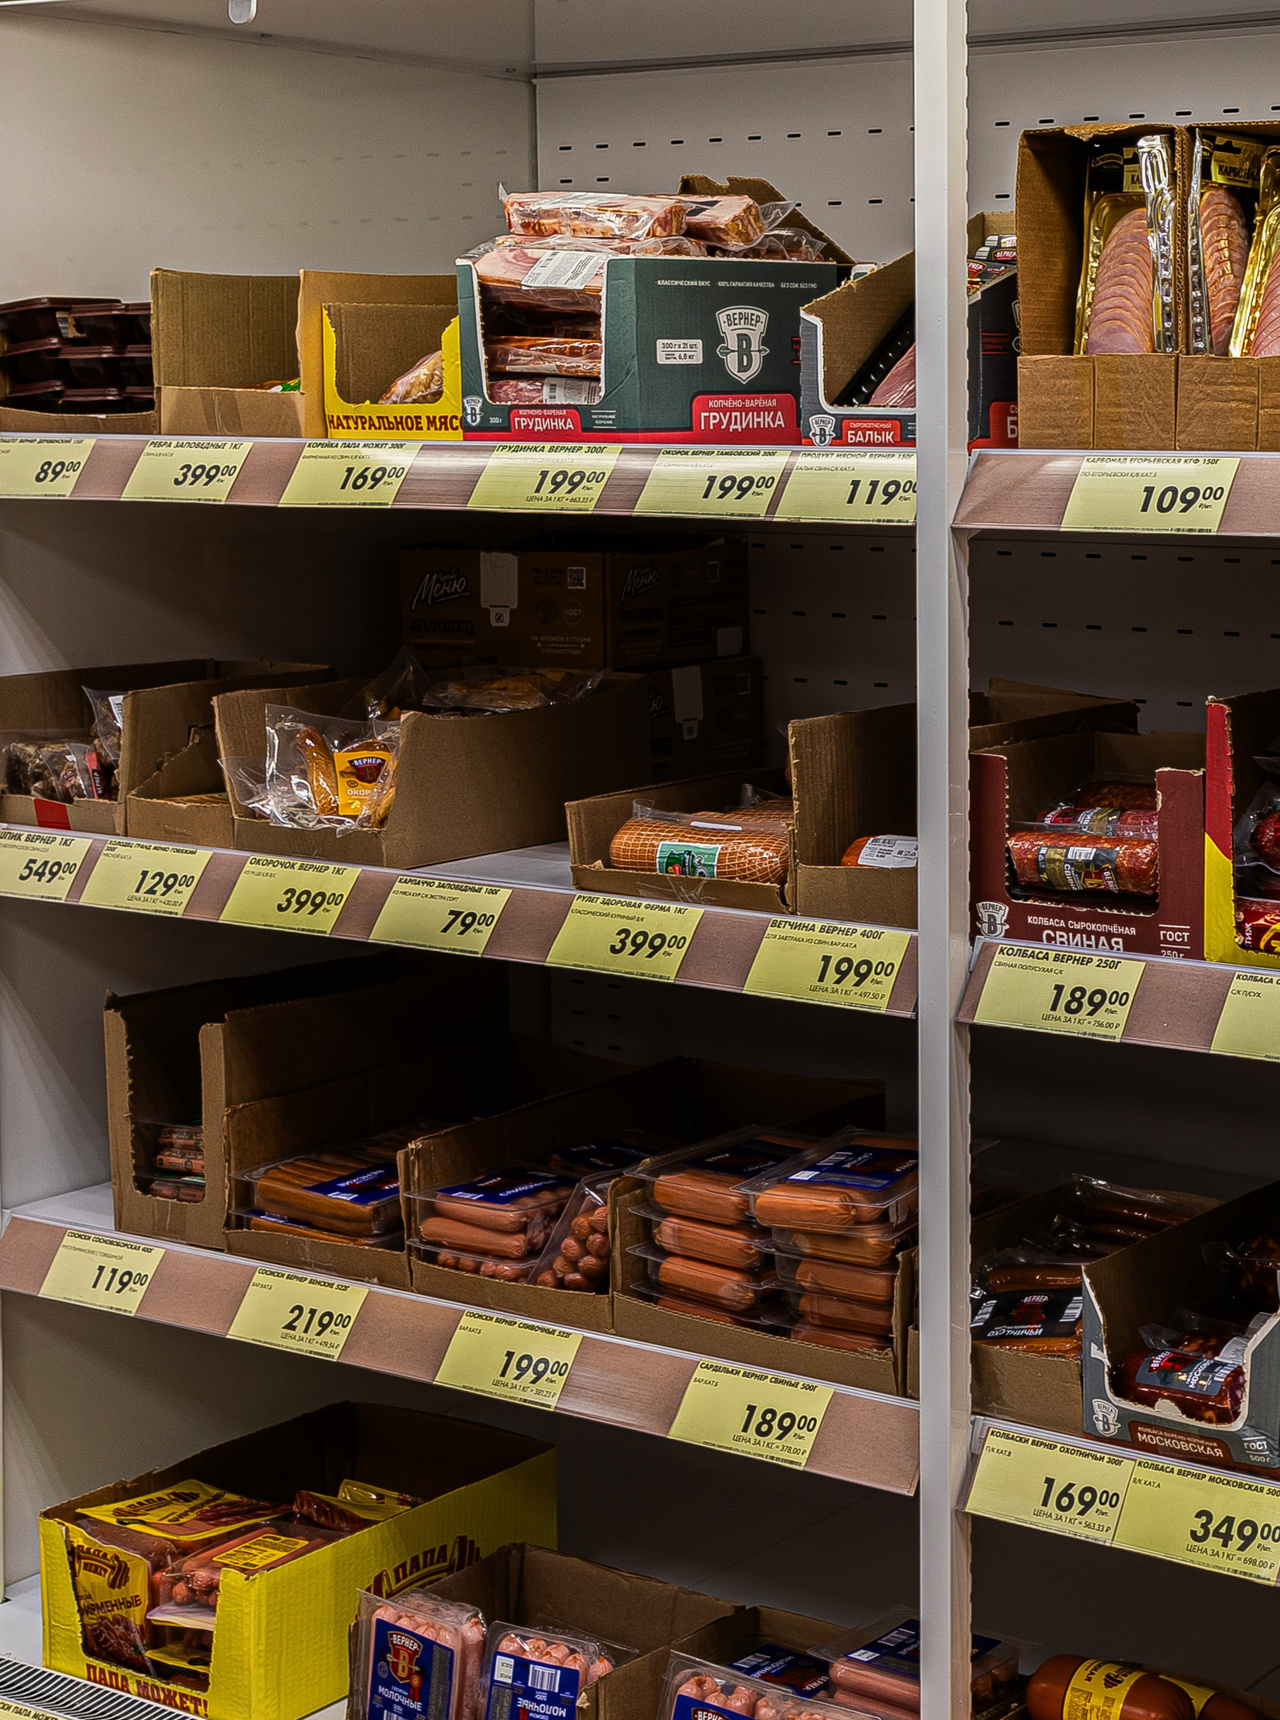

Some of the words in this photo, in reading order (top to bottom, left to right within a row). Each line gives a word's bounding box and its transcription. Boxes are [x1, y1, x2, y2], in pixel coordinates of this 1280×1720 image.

[726, 312, 761, 327] ВЕРНЕР
[328, 414, 424, 431] НАТУРАЛЬНОЕ
[514, 418, 574, 431] ГРУДИНКА
[700, 411, 785, 432] ГРУДИНКА
[149, 441, 172, 449] РЕБРА
[172, 442, 228, 450] ЗАПОВЕДНЫЕ
[306, 442, 339, 450] КОРЕЙКА
[848, 430, 894, 445] БАЛЫК
[496, 444, 546, 454] ГРУДИНКА
[548, 446, 582, 454] ВЕРНЕР
[585, 446, 607, 454] 300Г
[716, 450, 761, 458] ТАМБОВСКИЙ
[835, 452, 866, 460] МЯСНОЙ
[354, 758, 382, 766] ВЕРНЕР
[24, 834, 56, 844] ВЕРНЕР
[250, 856, 297, 870] ОКОРОЧОК
[298, 861, 330, 875] ВЕРНЕР
[398, 877, 436, 888] КАРПАЧЧО
[436, 881, 484, 894] ЗАПОВЕДНЫЕ
[576, 894, 598, 904] РУЛЕТ
[600, 896, 642, 909] ЗДОРОВАЯ
[644, 902, 672, 913] ФЕРМА
[770, 919, 818, 934] ВЕТЧИНА
[819, 924, 858, 938] ВЕРНЕР
[860, 929, 885, 941] 400Г
[1028, 916, 1066, 928] КОЛБАСА
[1068, 920, 1136, 936] СЫРОКОПЧЁНАЯ
[1042, 930, 1124, 952] СВИНАЯ
[1160, 930, 1190, 942] ГОСТ
[998, 946, 1050, 962] КОЛБАСА
[1052, 952, 1094, 967] ВЕРНЕР
[1096, 958, 1122, 970] 250Г
[1236, 974, 1274, 985] КОЛБАСА
[466, 1311, 494, 1322] СОСИСКИ
[518, 1322, 556, 1336] СЛИВОЧНЫЕ
[987, 1328, 1044, 1337] ОХОТНИЧЬИ
[700, 1362, 741, 1377] САРДЕЛЬКИ
[742, 1370, 769, 1382] ВЕРНЕР
[770, 1376, 800, 1389] СВИНЫЕ
[990, 1429, 1028, 1446] КОЛБАСКИ
[1030, 1437, 1058, 1454] ВЕРНЕР
[1059, 1444, 1104, 1463] ОХОТНИЧЬИ
[1106, 1456, 1124, 1467] 300Г
[1138, 1432, 1224, 1458] МОСКОВСКАЯ
[1244, 1440, 1268, 1451] ГОСТ
[1137, 1460, 1176, 1476] КОЛБАСА
[1177, 1468, 1207, 1483] ВЕРНЕР
[1208, 1474, 1266, 1495] МОСКОВСКАЯ
[394, 1544, 448, 1584] ПАПА
[392, 1635, 418, 1650] ВЕРНЕР
[86, 1663, 130, 1692] ПАПА
[136, 1679, 208, 1718] МОЖЕТ!
[378, 1684, 422, 1712] МОЛОЧНЫЕ
[516, 1698, 566, 1718] МОЛОЧНЫЕ
